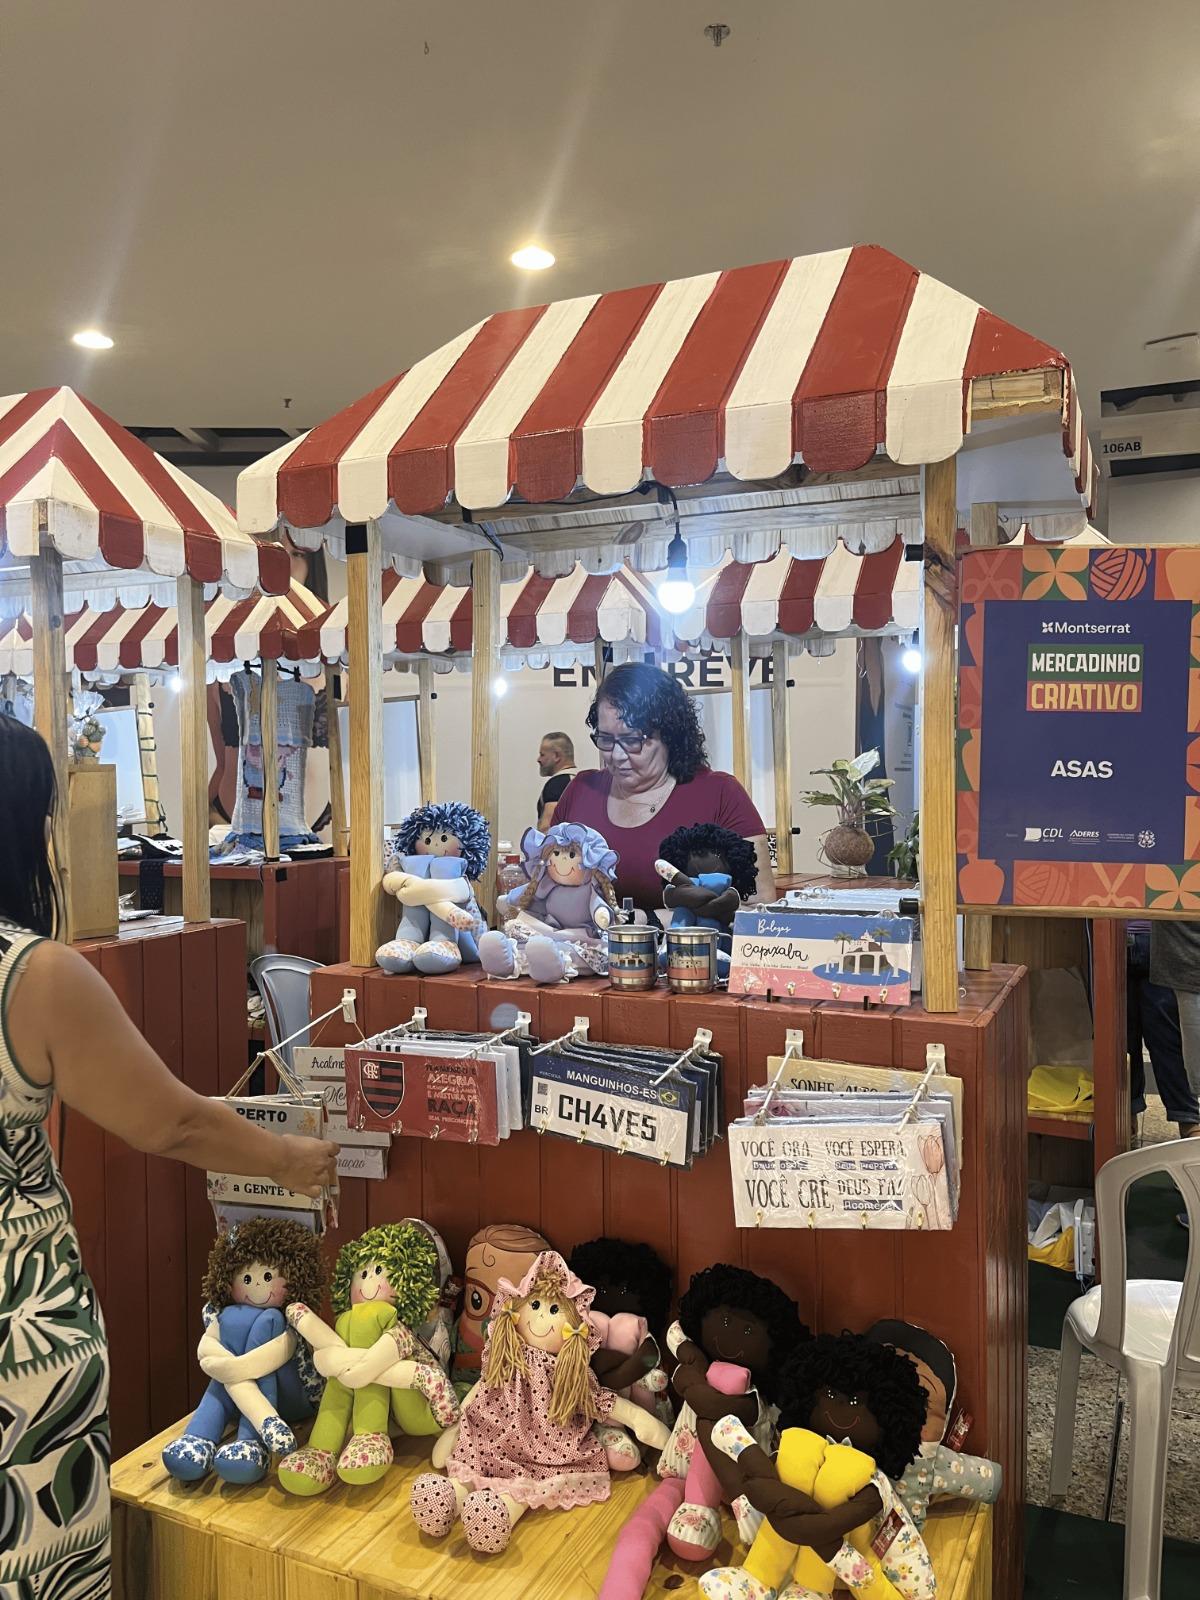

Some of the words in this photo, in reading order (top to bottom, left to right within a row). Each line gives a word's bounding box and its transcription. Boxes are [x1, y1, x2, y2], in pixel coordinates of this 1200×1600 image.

[1103, 441, 1141, 453] 106AB
[1054, 622, 1131, 633] Montserrat
[1031, 653, 1140, 673] MERCADINHO
[1031, 683, 1138, 710] CRIATIVO
[1050, 759, 1113, 779] ASAS
[1042, 828, 1063, 838] CDL
[1069, 829, 1099, 838] ADERES
[566, 1069, 658, 1100] MANGUINHOS-ES
[534, 1104, 548, 1116] BR
[741, 1138, 775, 1157] VOCÊ
[825, 1138, 855, 1157] VOCÊ
[233, 1184, 240, 1192] a
[244, 1183, 285, 1196] GENTE
[745, 1174, 790, 1209] VOCÊ
[798, 1175, 835, 1212] CRÊ,
